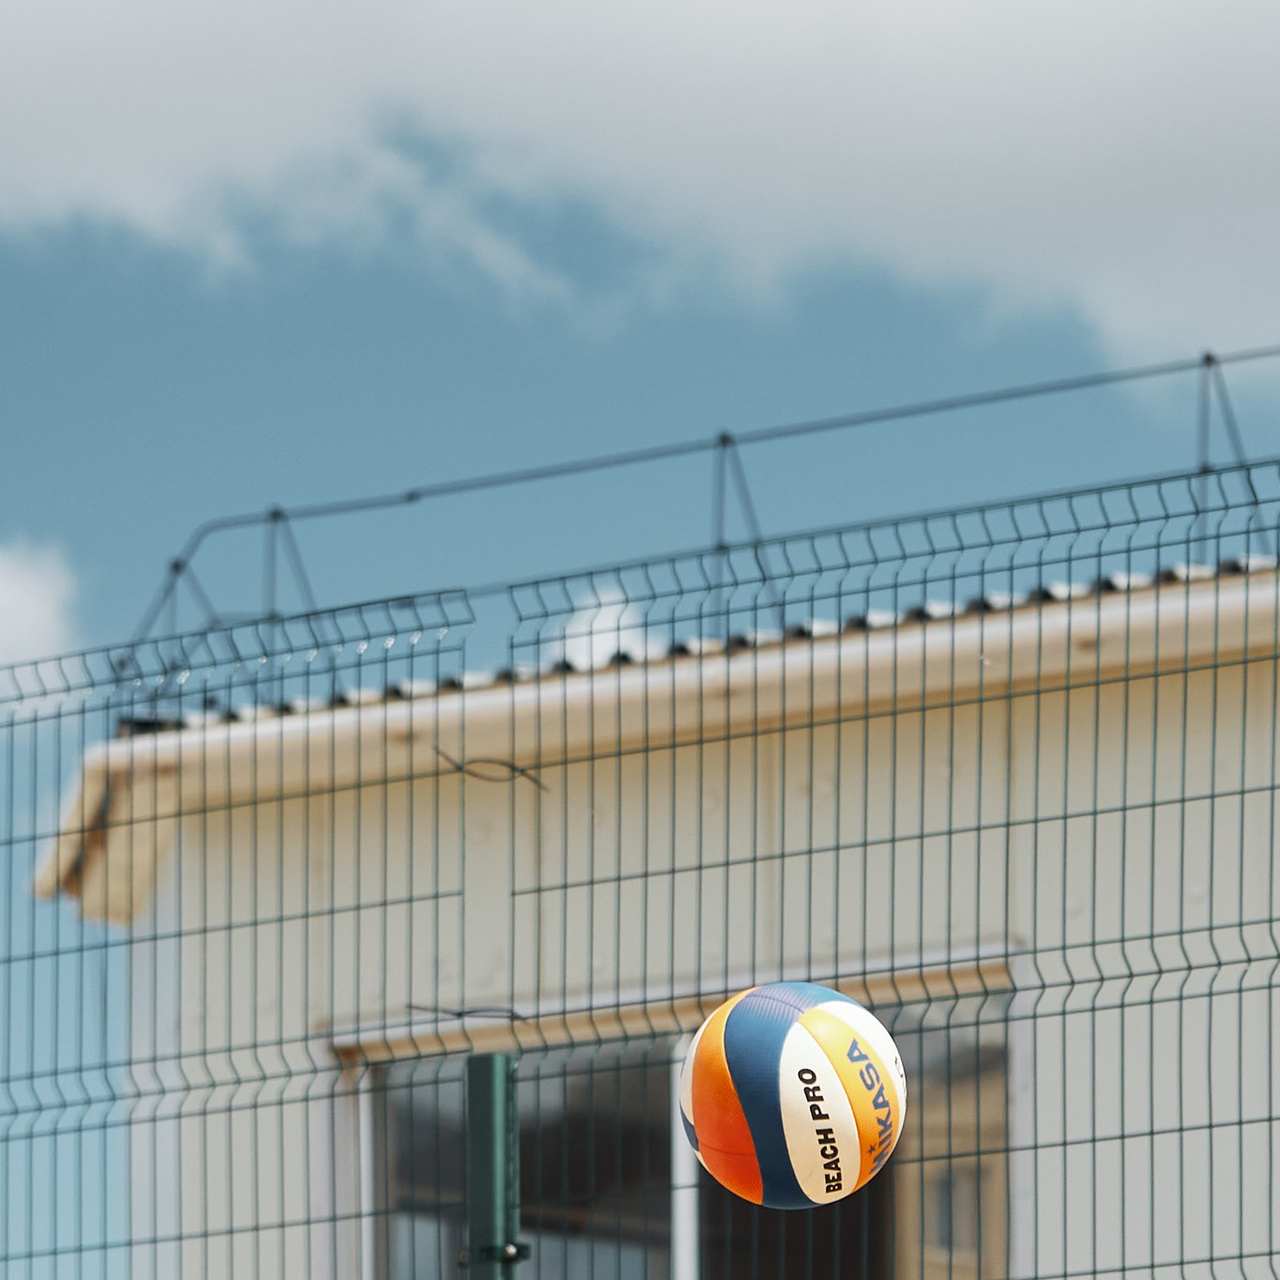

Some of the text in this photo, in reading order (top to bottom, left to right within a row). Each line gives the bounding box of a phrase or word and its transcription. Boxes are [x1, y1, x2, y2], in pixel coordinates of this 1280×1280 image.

[797, 1067, 843, 1194] BEACH PRO
[847, 1037, 894, 1175] MIKASA
